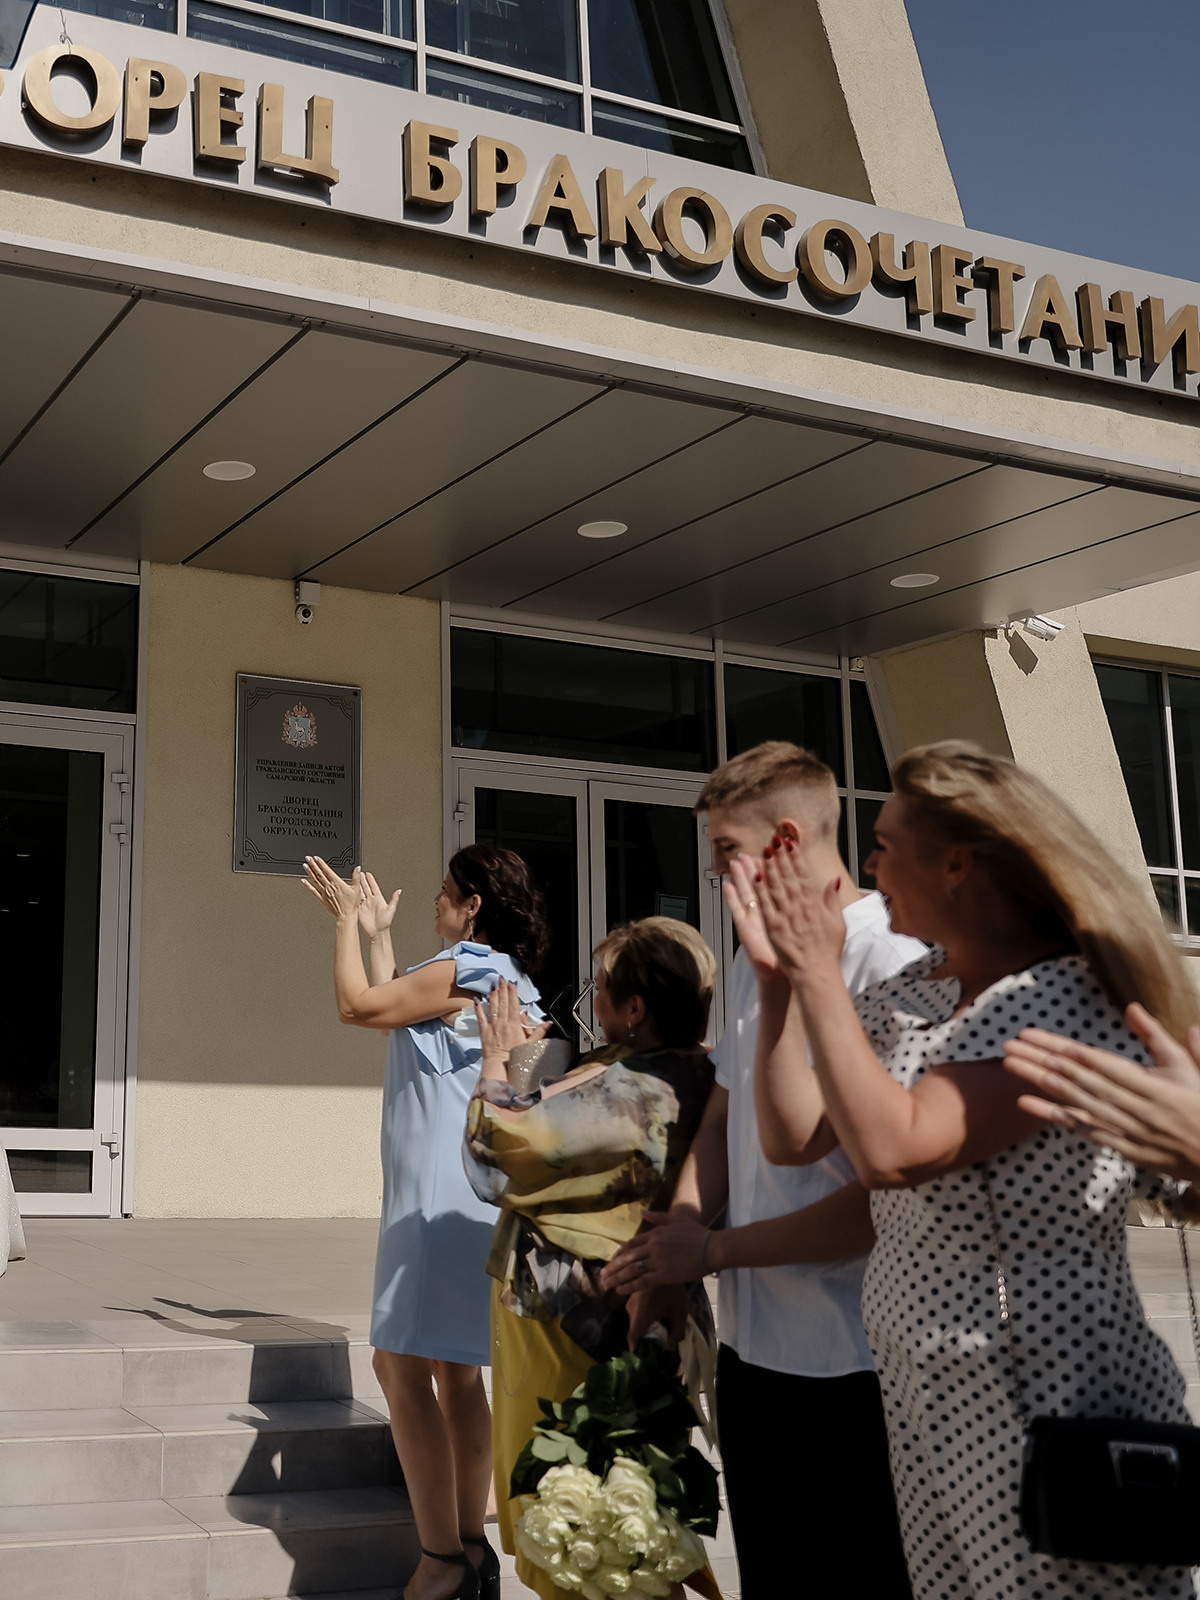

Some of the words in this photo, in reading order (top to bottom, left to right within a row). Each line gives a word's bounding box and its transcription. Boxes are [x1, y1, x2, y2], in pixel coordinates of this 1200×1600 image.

[403, 119, 1200, 376] БРАКОСОЧЕТАНИ
[256, 759, 297, 767] УПРАВЛЕНИЕ
[299, 762, 323, 770] ЗАПИСИ
[256, 766, 306, 775] ГРАЖДАНСКОГО
[307, 771, 345, 779] СОСТОЯНИЯ
[266, 774, 305, 782] САМАРСКОЙ
[282, 796, 319, 806] ДВОРЕЦ
[258, 805, 343, 818] БРАКОСОЧЕТАНИЯ
[270, 816, 331, 828] ГОРОДСКОГО
[263, 826, 299, 836] ОКРУГА
[301, 829, 338, 839] САМАРА
